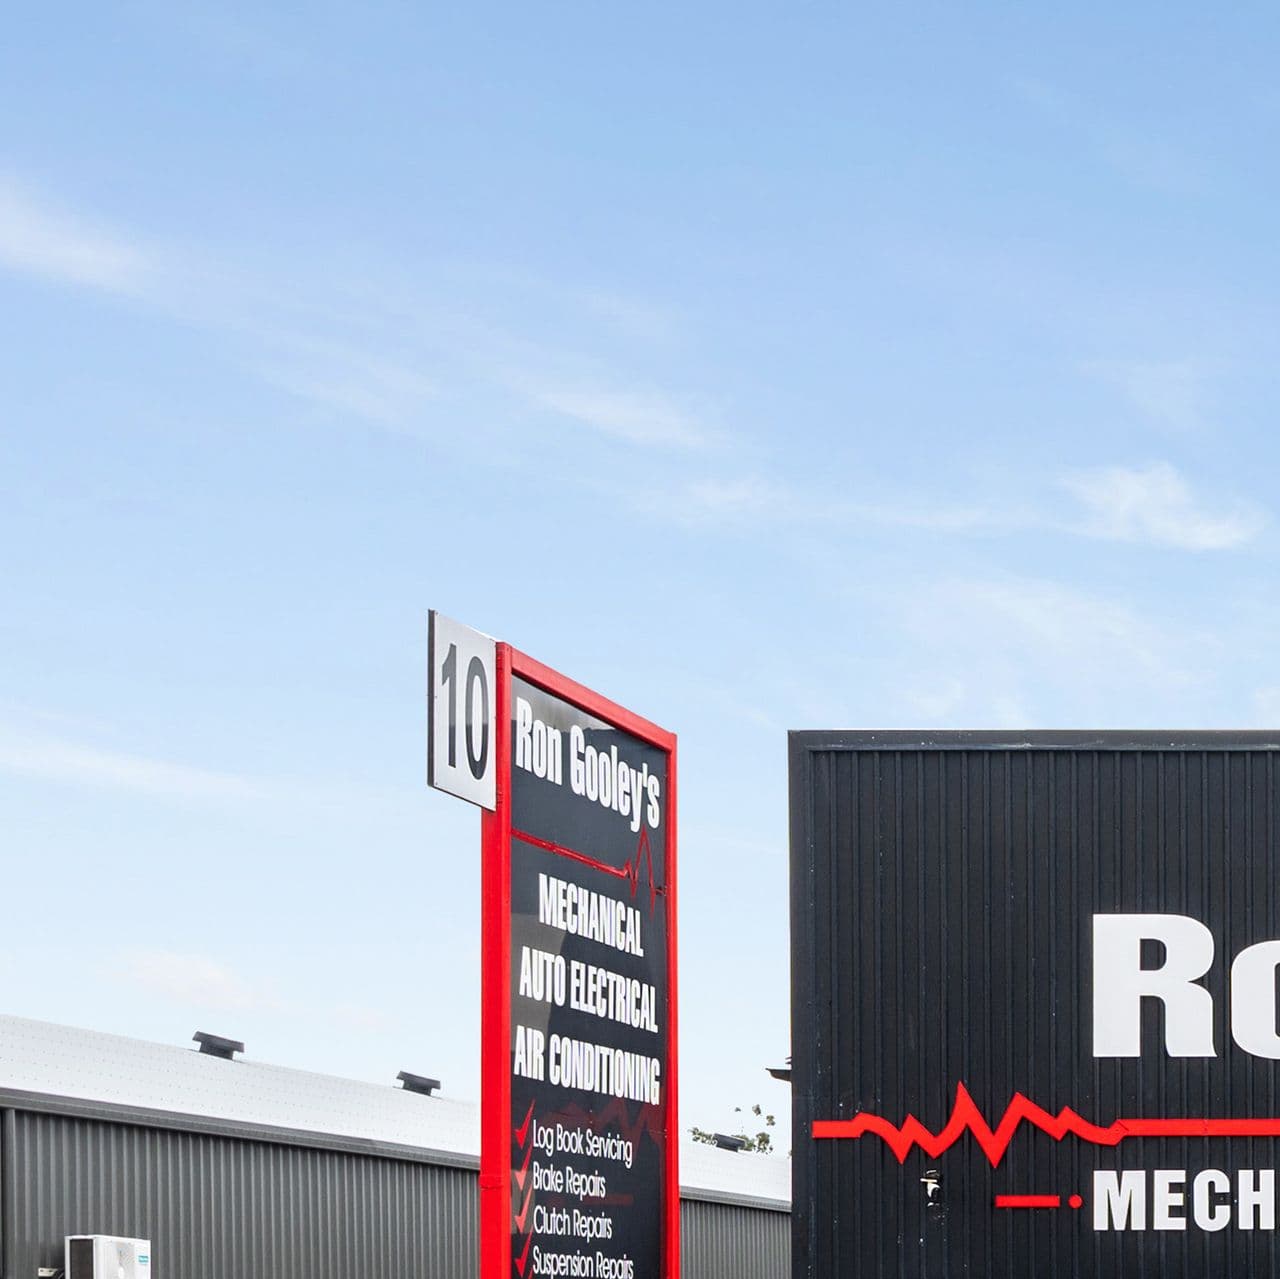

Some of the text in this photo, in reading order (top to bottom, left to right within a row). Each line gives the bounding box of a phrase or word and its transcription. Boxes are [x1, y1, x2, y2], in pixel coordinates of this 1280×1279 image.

[441, 643, 489, 780] 10
[515, 696, 660, 833] Ron Gooley's
[538, 873, 644, 957] MECHANICAL
[519, 946, 659, 1033] AUTO ELECTRICAL
[513, 1025, 660, 1105] AIR CONDITIONING
[533, 1119, 633, 1169] Log Book Servicing
[533, 1161, 606, 1201] Brake Repairs
[533, 1205, 612, 1243] Clutch Repairs
